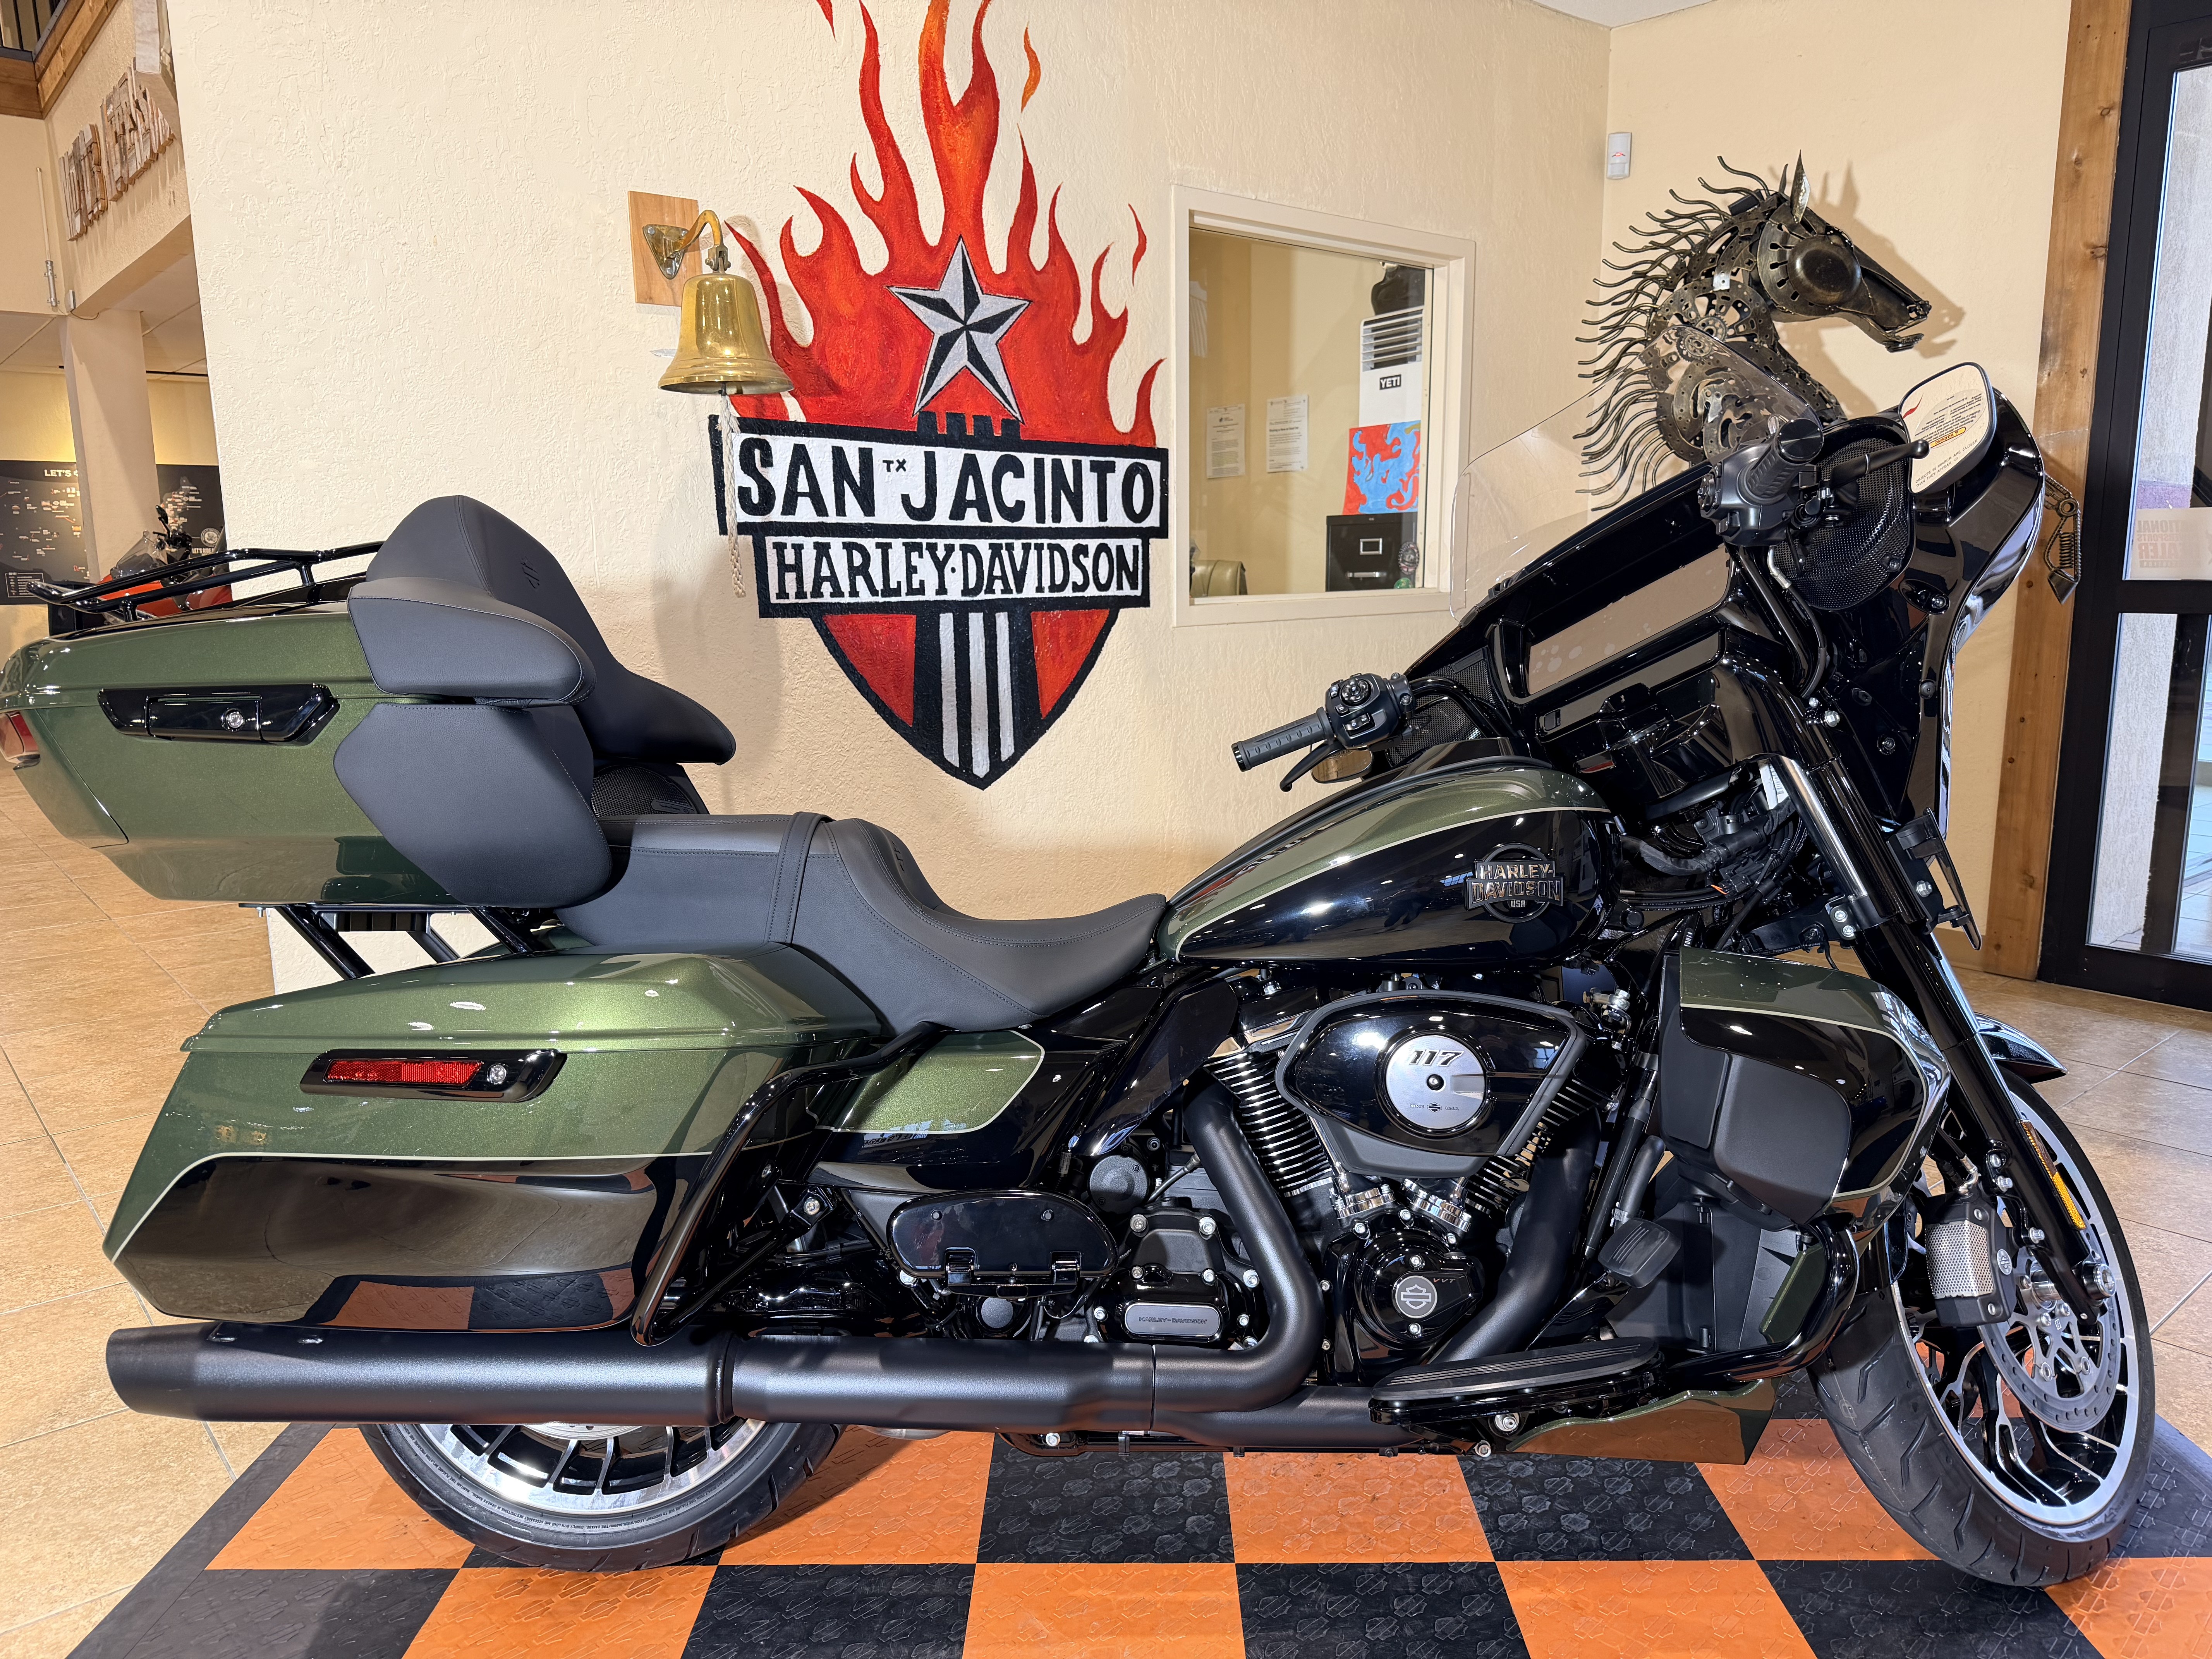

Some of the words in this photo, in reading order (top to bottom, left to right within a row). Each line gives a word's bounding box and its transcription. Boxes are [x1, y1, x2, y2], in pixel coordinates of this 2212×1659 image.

[1381, 377, 1400, 388] YETI
[883, 459, 907, 472] TX
[1915, 471, 1931, 484] OBJECTS
[1937, 456, 1952, 468] MIRROR
[1962, 439, 1978, 451] CLOSER
[1937, 461, 1952, 474] APPEAR
[737, 437, 876, 519] SAN
[900, 450, 1154, 524] JACINTO
[1472, 880, 1560, 903] DAVIDSON
[1408, 1049, 1464, 1067] 117
